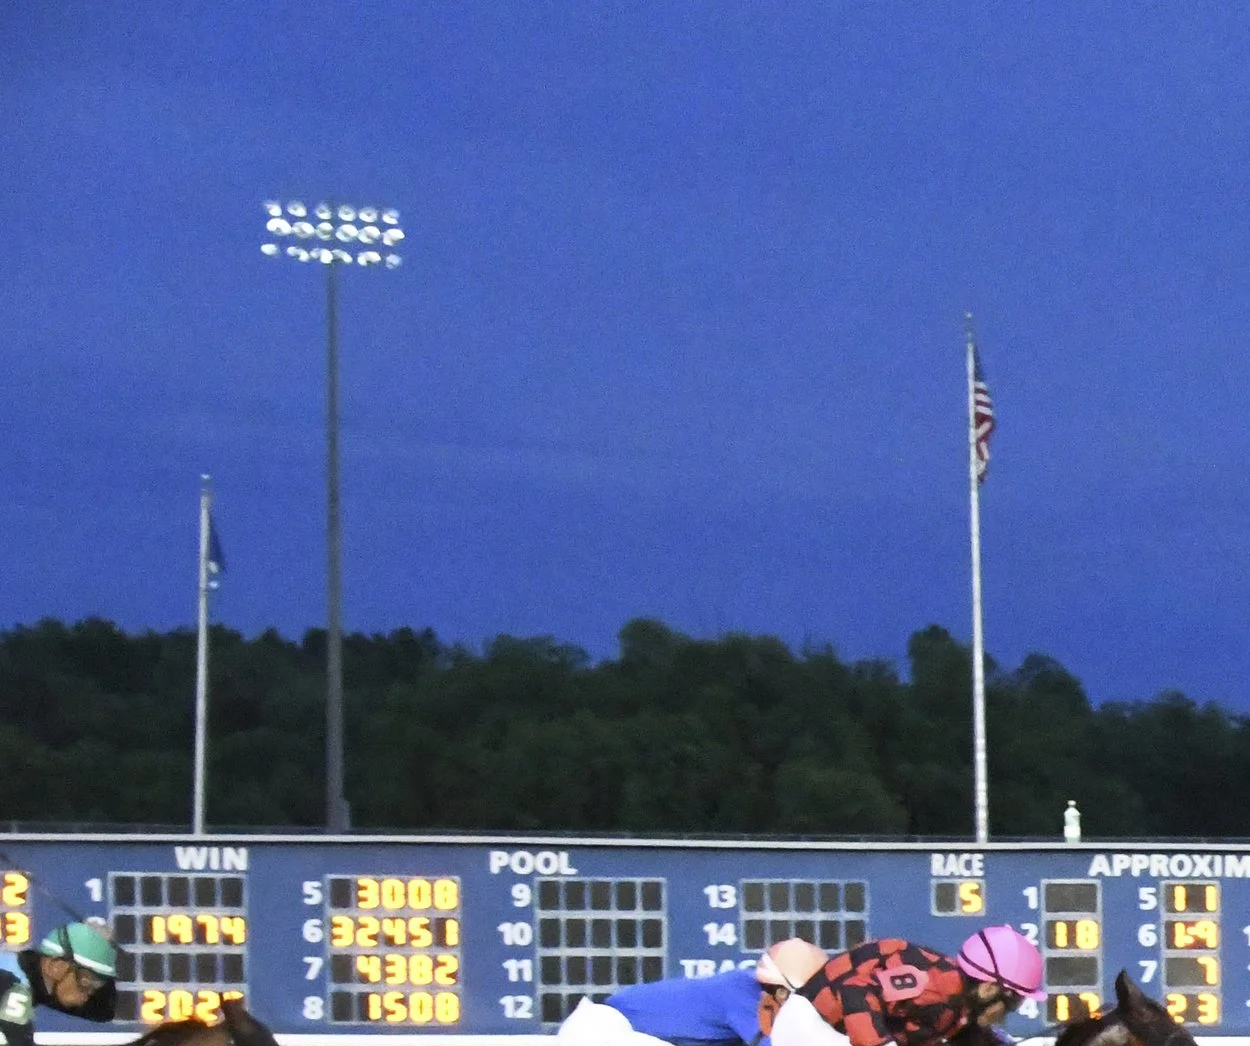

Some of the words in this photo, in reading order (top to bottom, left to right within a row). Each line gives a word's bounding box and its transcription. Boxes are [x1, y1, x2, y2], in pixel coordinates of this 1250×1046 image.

[174, 846, 248, 871] WIN
[489, 850, 577, 875] POOL
[930, 853, 984, 877] RACE
[85, 878, 102, 902] 1
[302, 880, 323, 905] 5
[357, 877, 459, 912] 3008
[511, 883, 532, 908] 9
[703, 884, 737, 909] 13
[959, 881, 983, 913] 5
[1022, 886, 1039, 909] 1
[1138, 887, 1158, 911] 5
[1174, 885, 1219, 912] 11
[152, 913, 246, 944] 1974
[302, 918, 324, 943] 6
[332, 915, 459, 950] 32451
[497, 921, 533, 946] 10
[703, 922, 738, 946] 14
[1019, 922, 1039, 946] 2
[1055, 919, 1099, 951] 18
[1137, 923, 1158, 947] 6
[303, 956, 323, 980] 7
[356, 952, 459, 987] 4382
[502, 959, 533, 982] 11
[1138, 960, 1158, 983] 7
[1197, 955, 1219, 985] 7
[5, 992, 28, 1018] 5
[140, 987, 245, 1026] 202
[302, 995, 324, 1020] 8
[368, 989, 460, 1025] 1508
[499, 995, 533, 1019] 12
[1167, 992, 1219, 1025] 23
